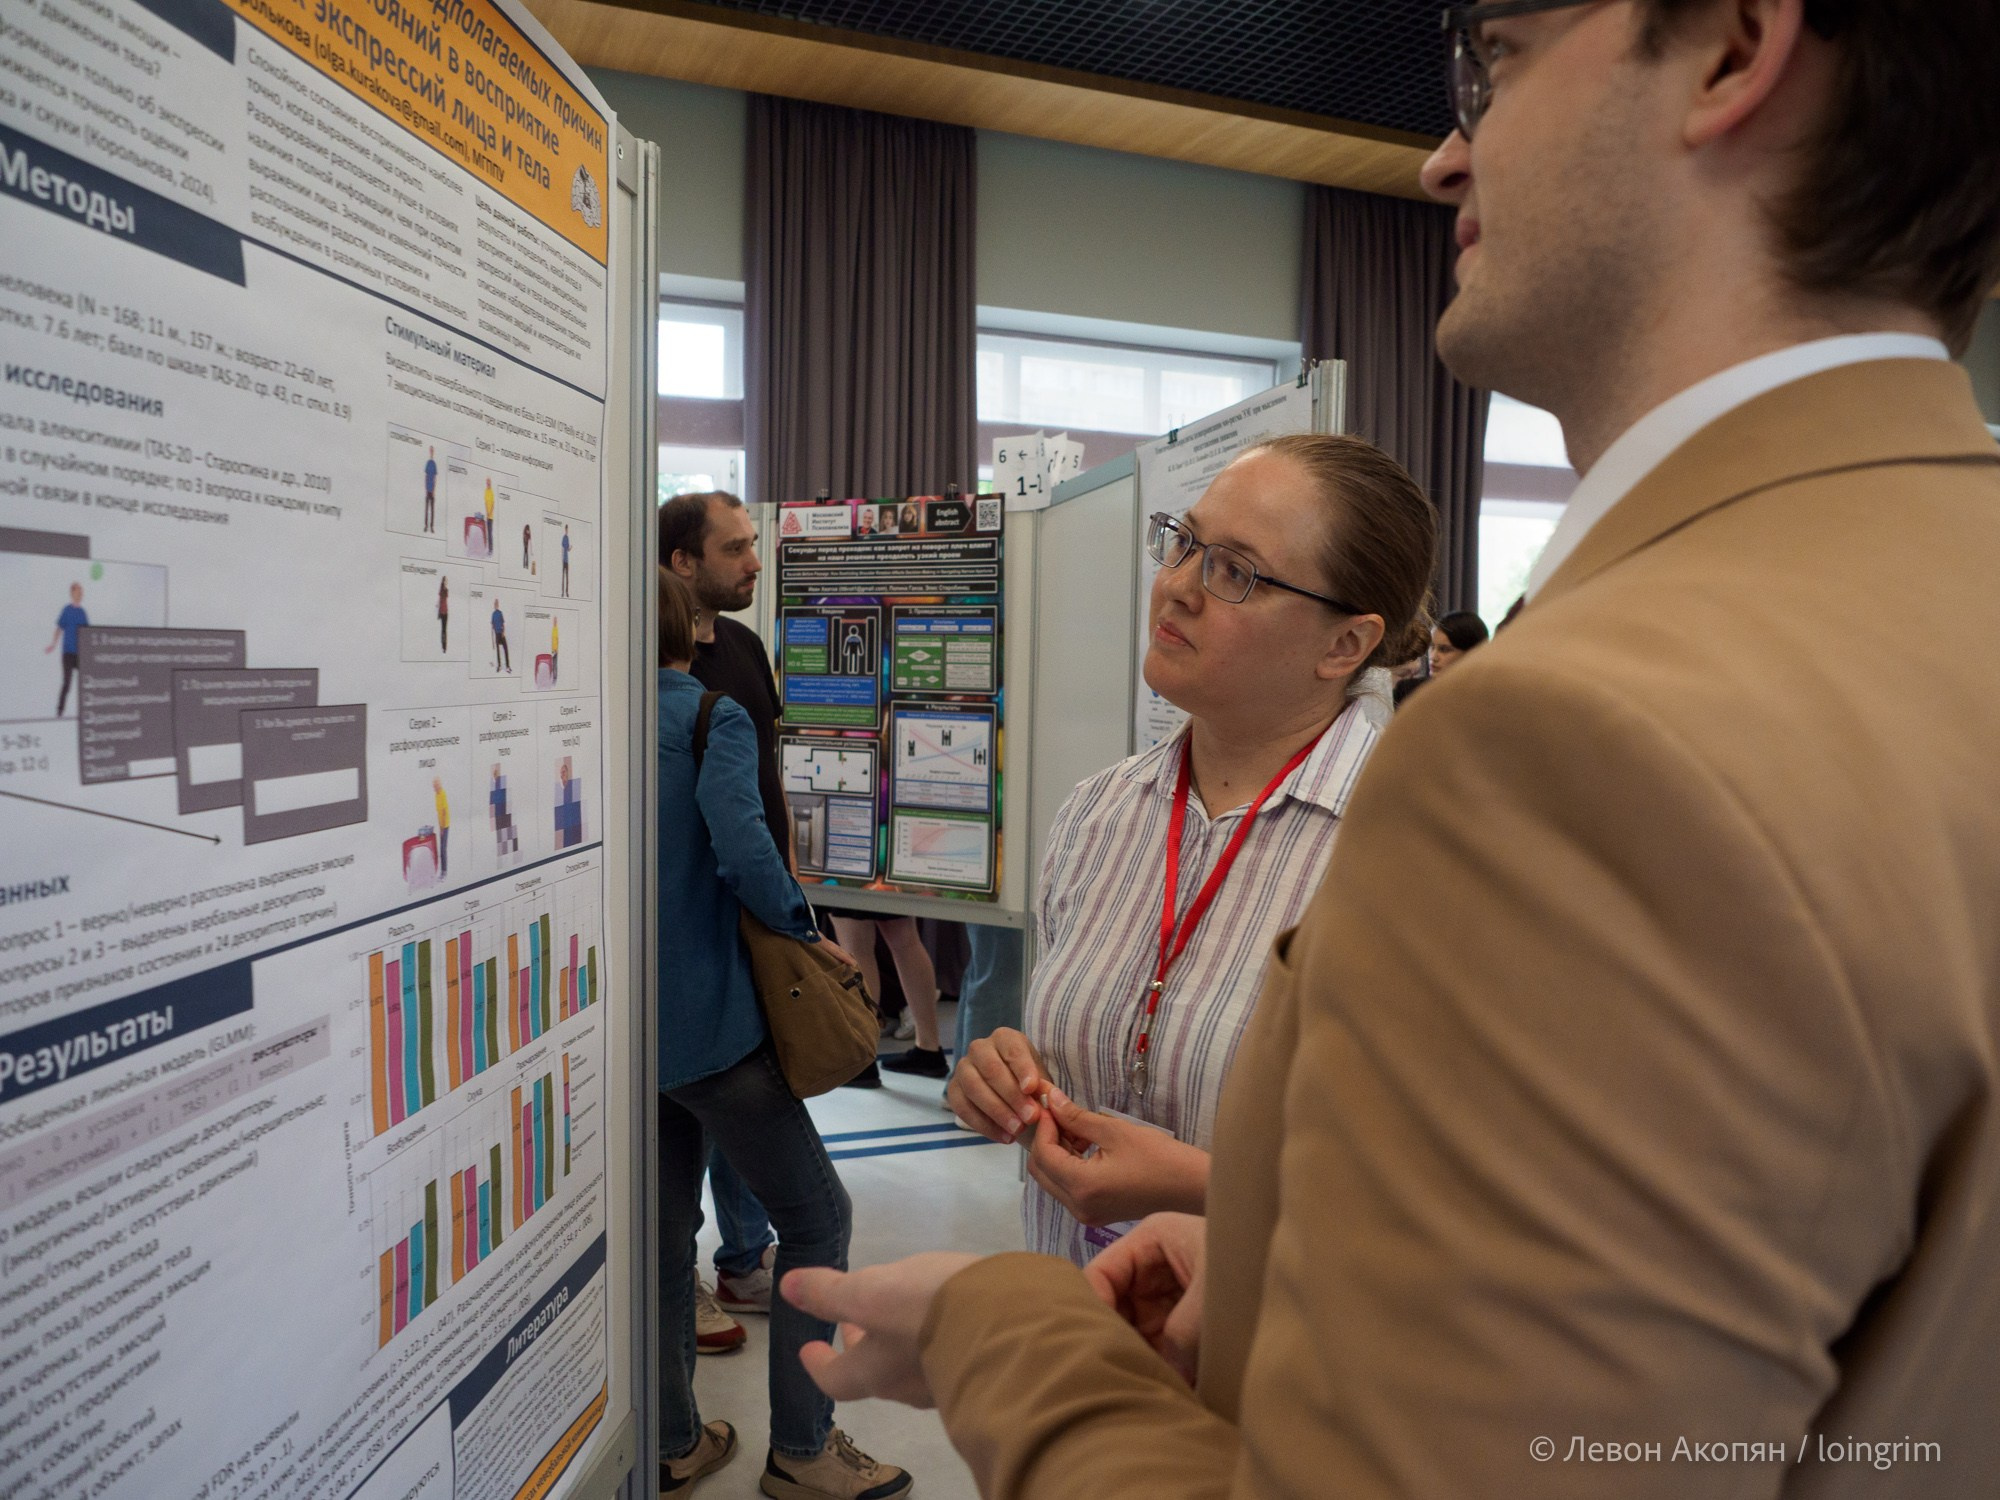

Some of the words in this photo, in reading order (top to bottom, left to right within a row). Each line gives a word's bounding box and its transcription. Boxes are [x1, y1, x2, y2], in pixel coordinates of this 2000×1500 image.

[314, 0, 445, 112] экспрессий
[456, 98, 496, 151] лица
[502, 135, 512, 161] и
[517, 146, 550, 190] тела
[374, 0, 440, 61] ояний
[448, 46, 459, 74] в
[465, 59, 559, 155] восприятие
[430, 0, 550, 106] дполагаемых
[554, 92, 602, 153] причин
[0, 143, 136, 234] Методы
[5, 364, 163, 416] исследования
[386, 316, 451, 358] Стимульный
[454, 350, 495, 378] материал
[999, 450, 1007, 464] 6
[0, 1006, 174, 1094] Результаты
[506, 1287, 569, 1363] Литература
